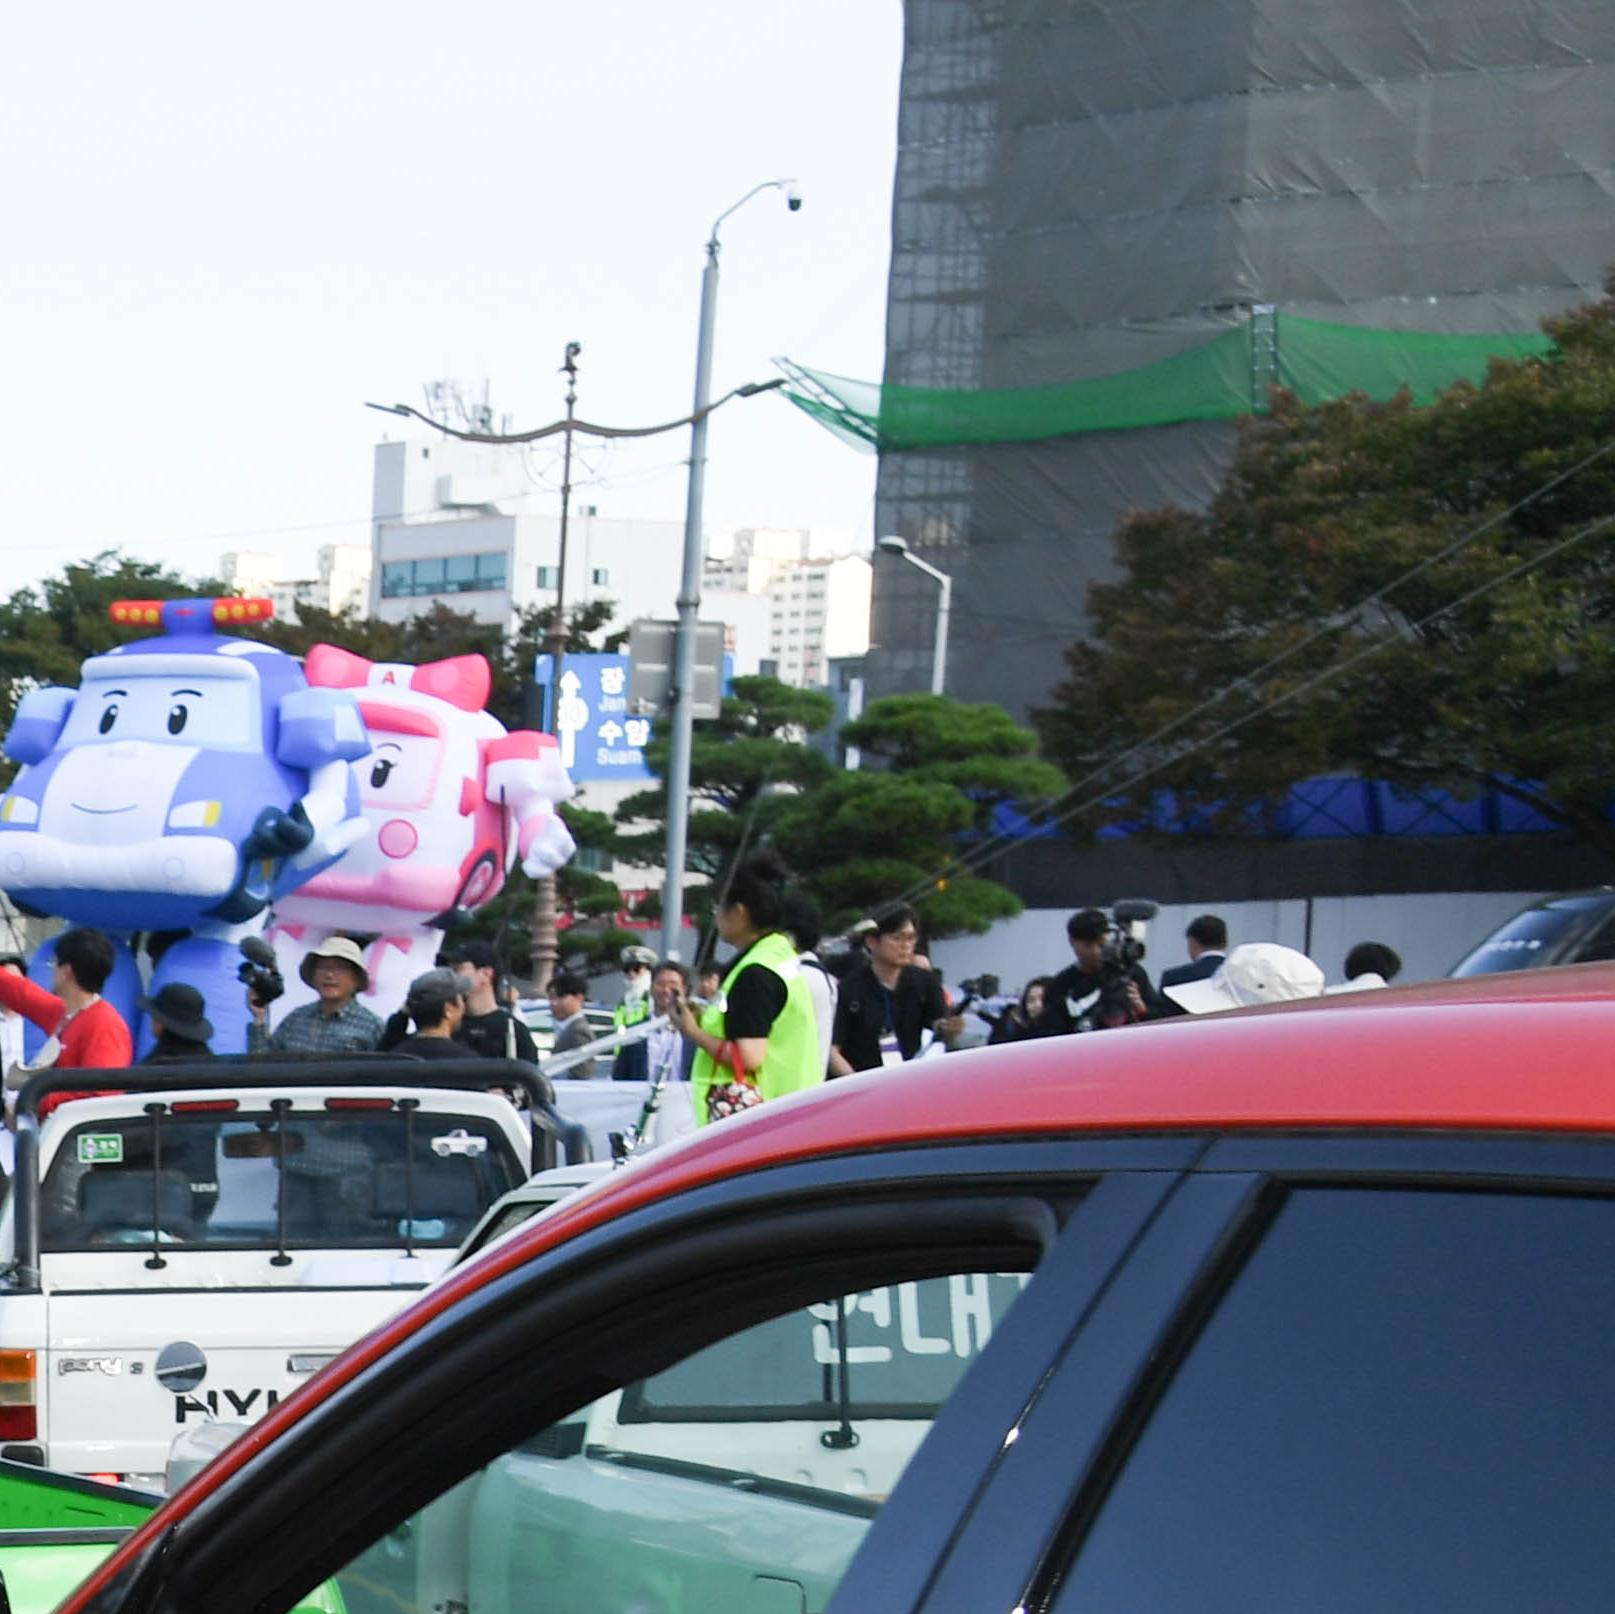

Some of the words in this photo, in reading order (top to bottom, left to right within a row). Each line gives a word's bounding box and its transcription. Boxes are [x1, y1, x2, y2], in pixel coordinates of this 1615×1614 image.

[380, 670, 397, 686] A
[597, 719, 651, 747] 수암
[807, 1272, 1034, 1364] 현대
[58, 1356, 124, 1377] pony
